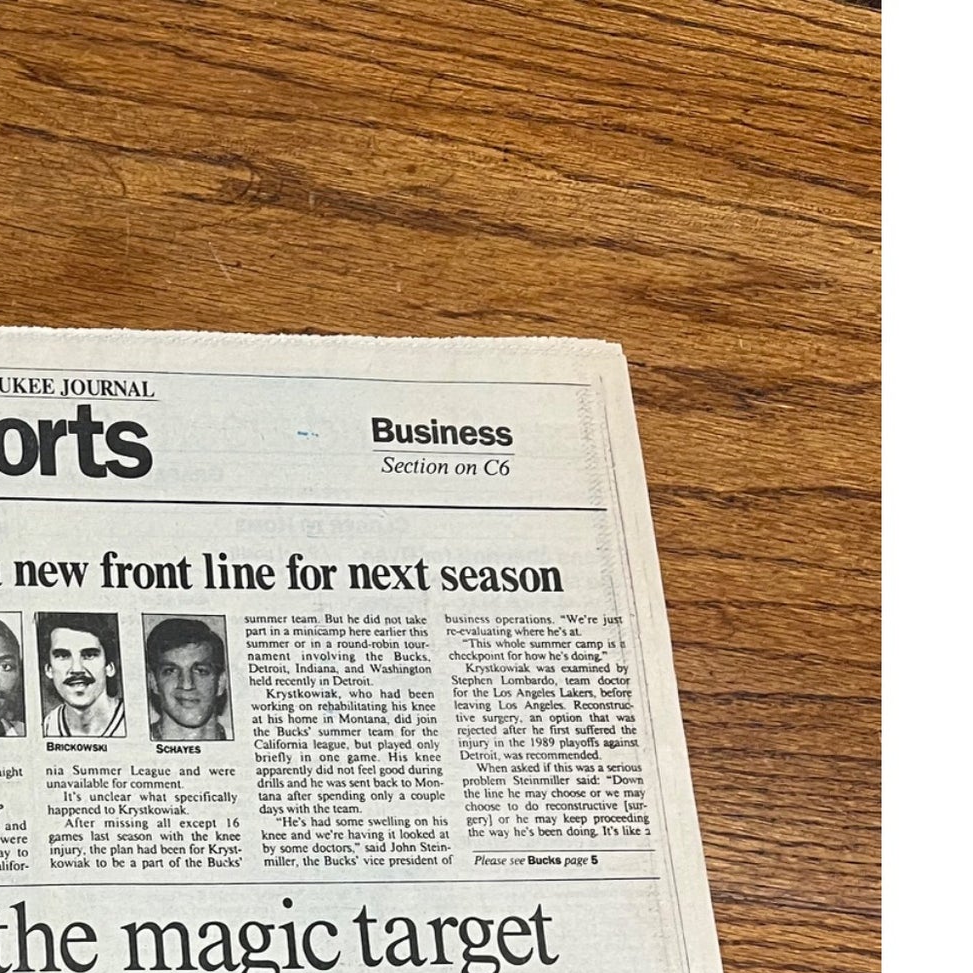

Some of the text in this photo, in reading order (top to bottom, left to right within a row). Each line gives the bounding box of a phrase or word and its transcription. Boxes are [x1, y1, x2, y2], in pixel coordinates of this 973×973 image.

[60, 379, 155, 398] JOURNAL
[371, 417, 514, 446] Business
[381, 456, 510, 476] Section on C6
[14, 559, 90, 588] new
[100, 551, 192, 590] front
[204, 552, 276, 590] line
[286, 552, 338, 591] for
[347, 557, 431, 592] next
[440, 561, 564, 593] season
[248, 663, 431, 676] Detroit, Indiana, and Washington
[465, 663, 530, 675] Krystkowiak
[560, 663, 610, 673] examined
[615, 663, 628, 675] by
[249, 676, 373, 688] held recently in Detroit.
[451, 675, 631, 687] Stephen Lombardo, team doctor
[46, 741, 108, 753] BRICKOWSKI
[156, 743, 201, 755] SCHAYES
[47, 804, 189, 817] happened to Krystkowiak.
[5, 820, 27, 831] and
[474, 855, 598, 867] Please see Bucks page 5
